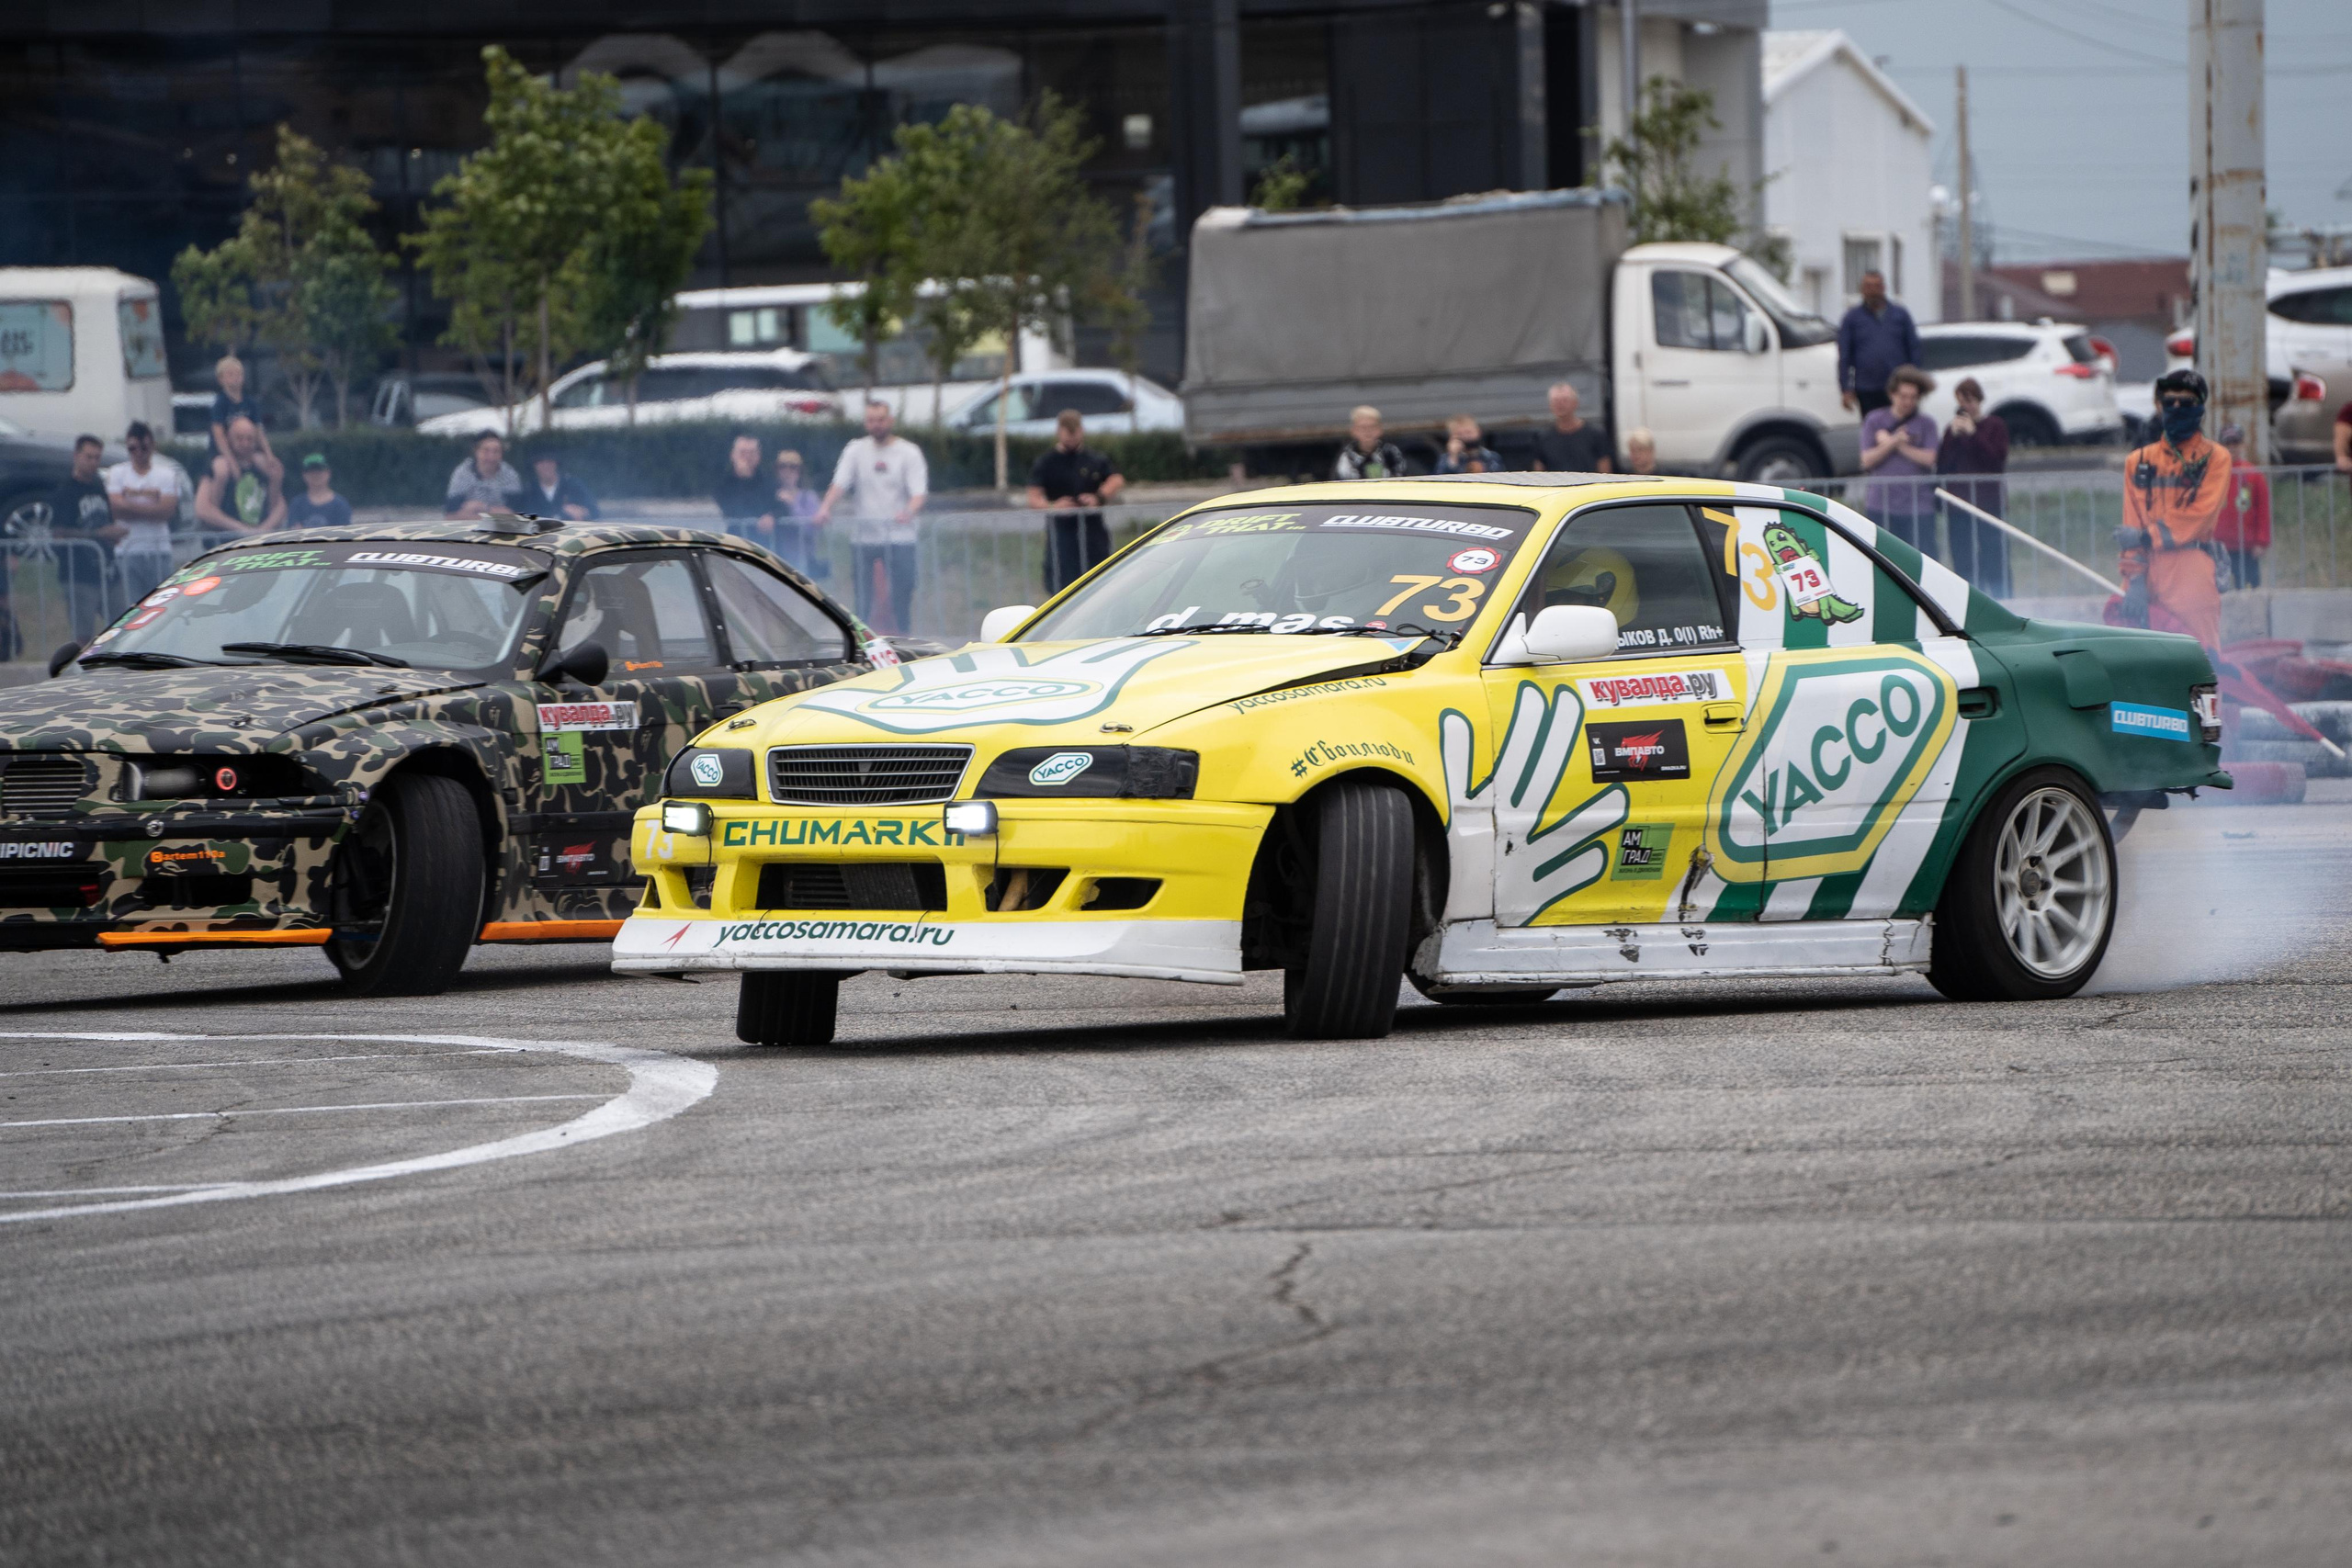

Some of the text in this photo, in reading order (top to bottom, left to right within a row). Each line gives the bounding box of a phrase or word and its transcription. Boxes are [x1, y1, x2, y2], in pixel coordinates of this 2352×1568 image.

[1196, 513, 1302, 530] DRIFT
[1320, 515, 1514, 539] CLUBTURBO
[220, 550, 326, 567] DRIFT
[1461, 555, 1489, 565] 73
[1790, 569, 1822, 592] 73
[1374, 574, 1487, 622] 73
[1698, 625, 1724, 640] Rh+
[899, 684, 1065, 705] YACCO
[1226, 677, 1387, 715] yaccosamara.ru
[1589, 672, 1718, 706] кувалда.ру
[2114, 709, 2188, 733] CLUBTURBO
[1614, 745, 1665, 757] ВМПАВТО
[1740, 673, 1921, 837] YACCO
[695, 758, 718, 781] YACCO
[1037, 757, 1084, 779] YACCO
[1623, 830, 1643, 846] АМ
[1622, 850, 1651, 863] ГРАД
[713, 920, 956, 949] yaccosamara.ru
